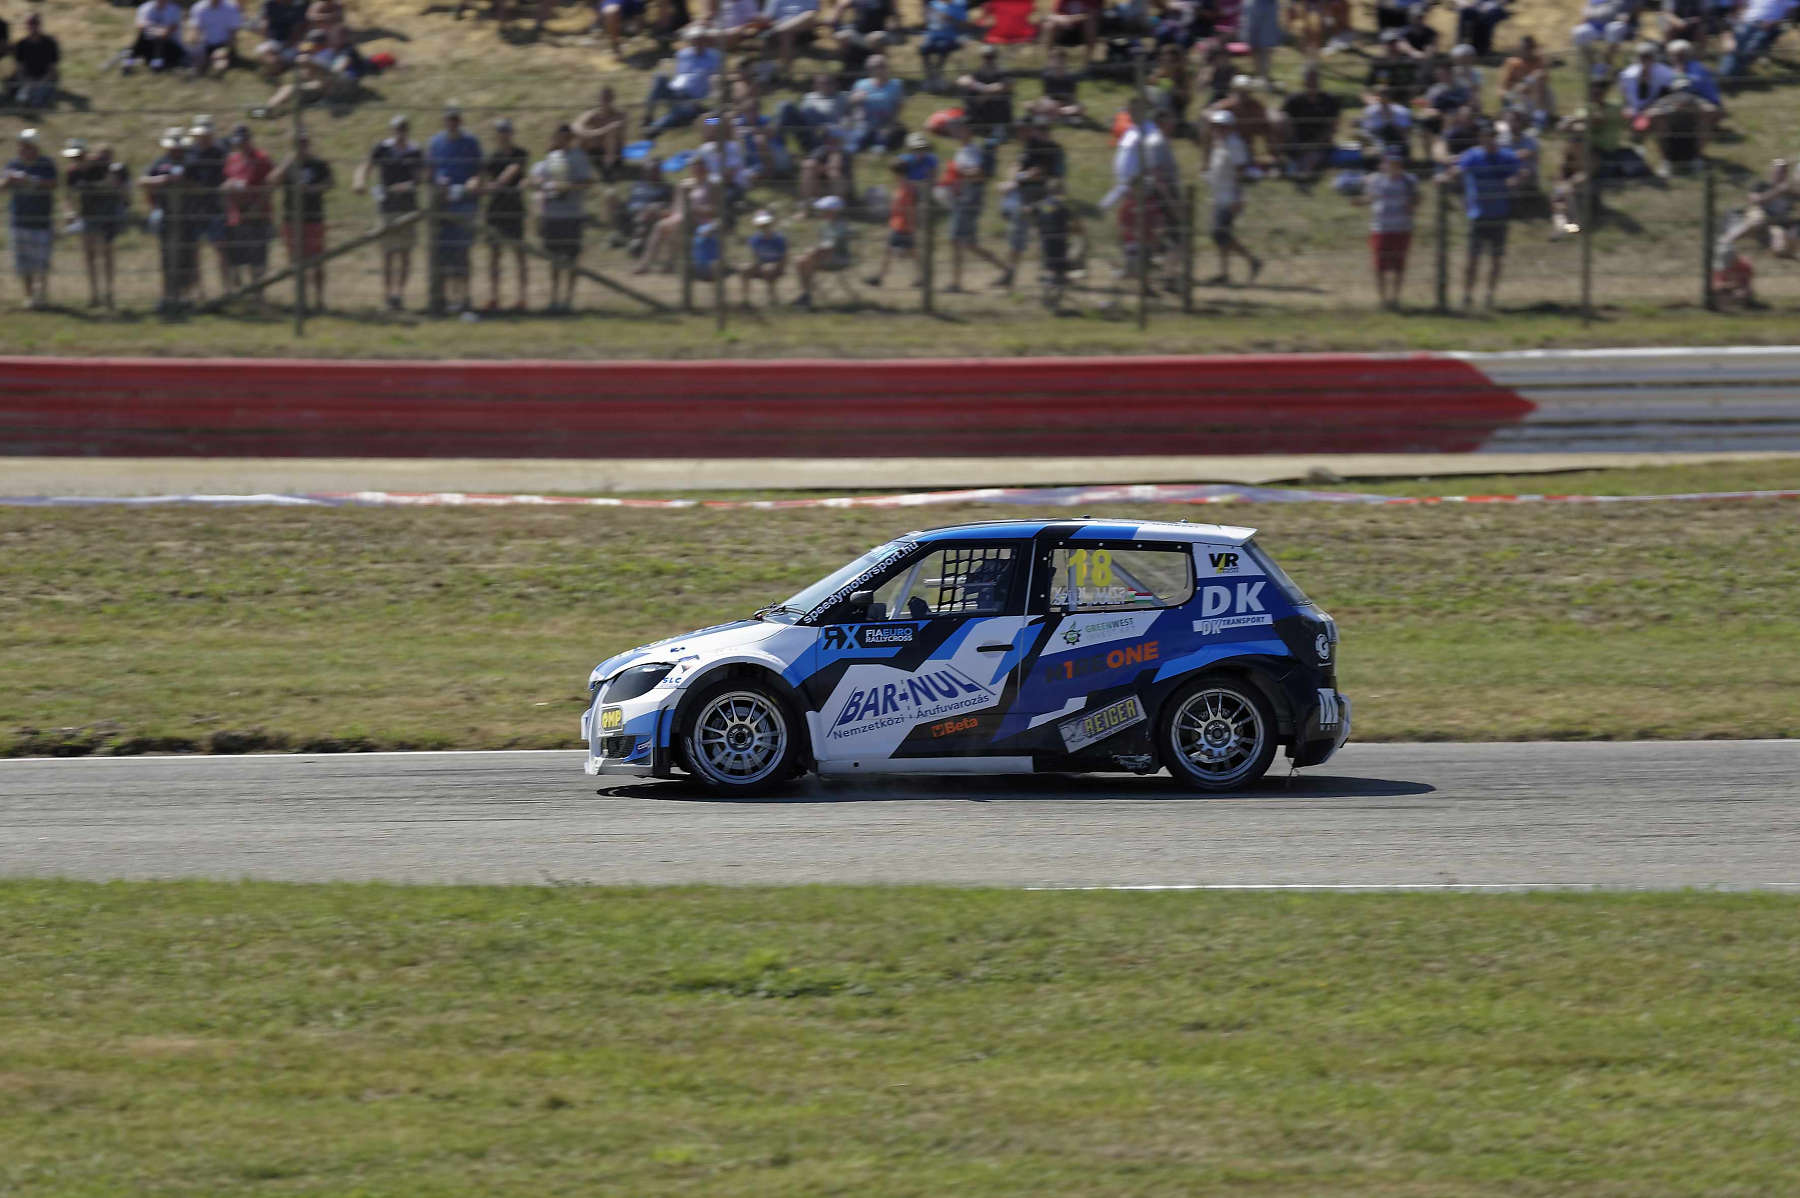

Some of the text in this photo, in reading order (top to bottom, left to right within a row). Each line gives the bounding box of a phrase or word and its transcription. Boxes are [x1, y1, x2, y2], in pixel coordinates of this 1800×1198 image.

[803, 541, 919, 624] speedymotorsport.hu
[1068, 548, 1112, 587] 18
[1201, 581, 1267, 618] DK
[865, 635, 912, 643] RALLYCROSS
[1222, 616, 1266, 626] TRANSPORT
[662, 676, 682, 684] SLC
[837, 670, 982, 726] BAR-NUL
[833, 694, 990, 740] Nemzetközi Árufuvarozás
[944, 717, 979, 734] Beta
[1085, 699, 1137, 734] REIGER
